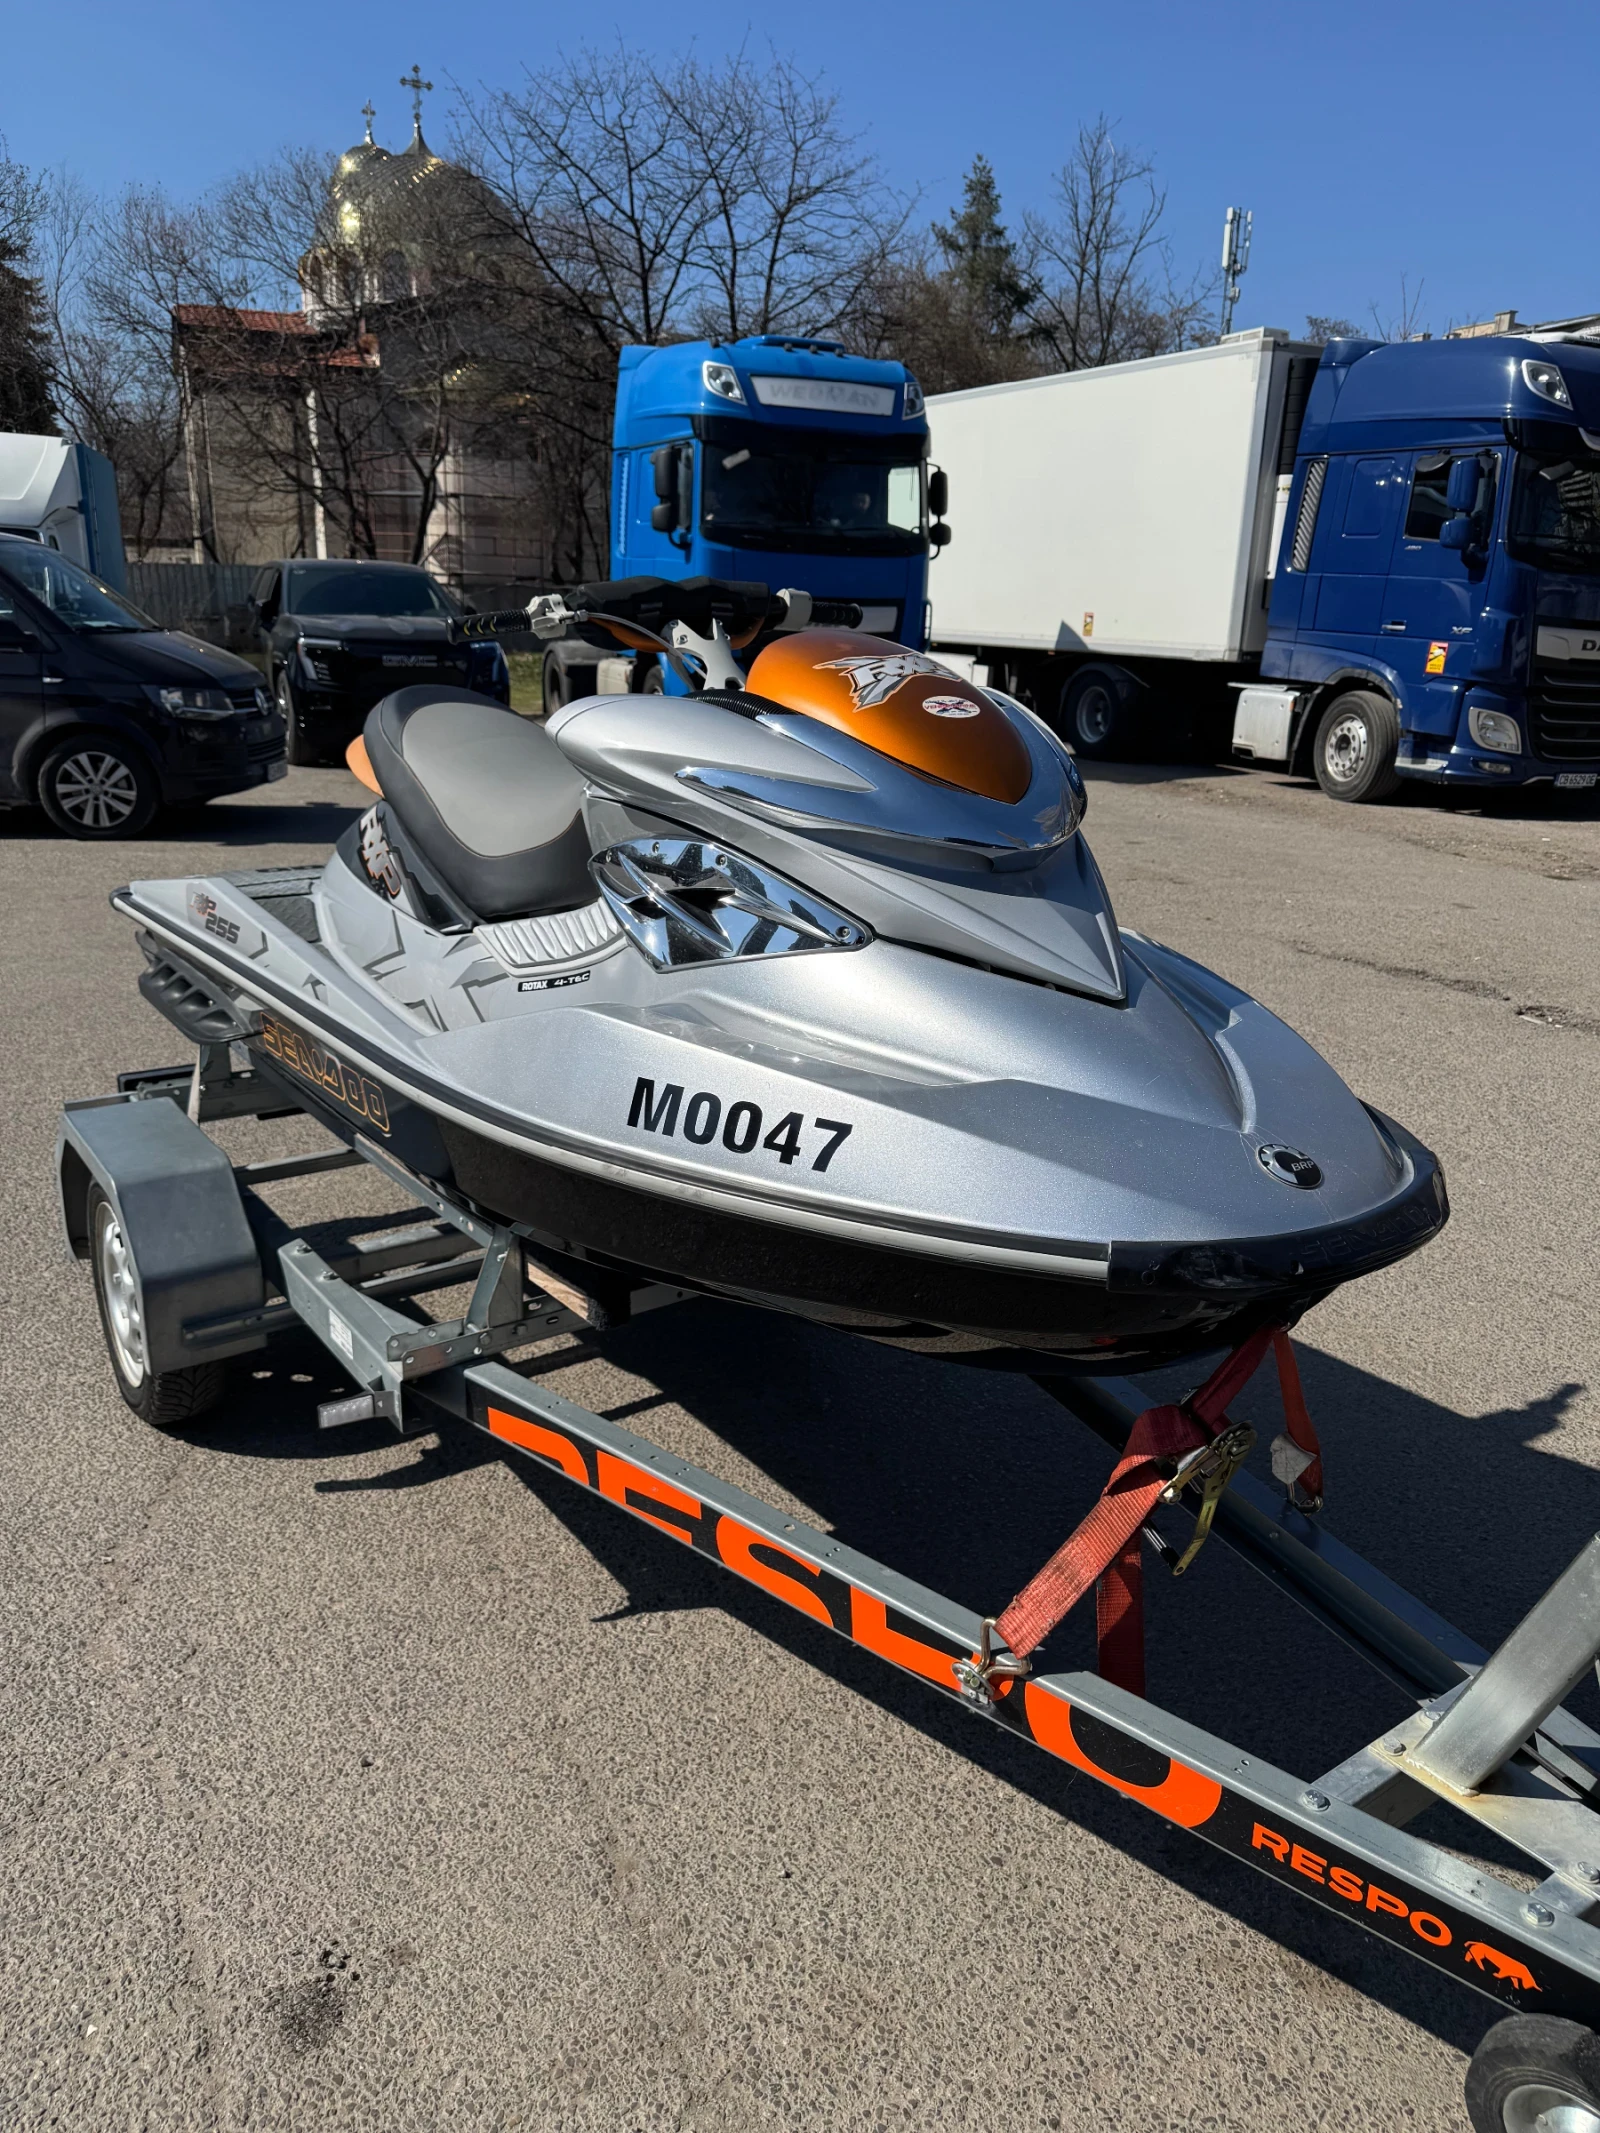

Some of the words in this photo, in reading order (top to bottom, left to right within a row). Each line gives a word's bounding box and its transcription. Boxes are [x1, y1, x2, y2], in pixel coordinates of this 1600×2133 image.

[1450, 626, 1473, 635] XF
[381, 655, 438, 667] GMC
[205, 911, 240, 944] 255
[521, 980, 548, 991] ROTAX
[1291, 1160, 1315, 1172] BRP
[1252, 1822, 1453, 1947] RESPO
